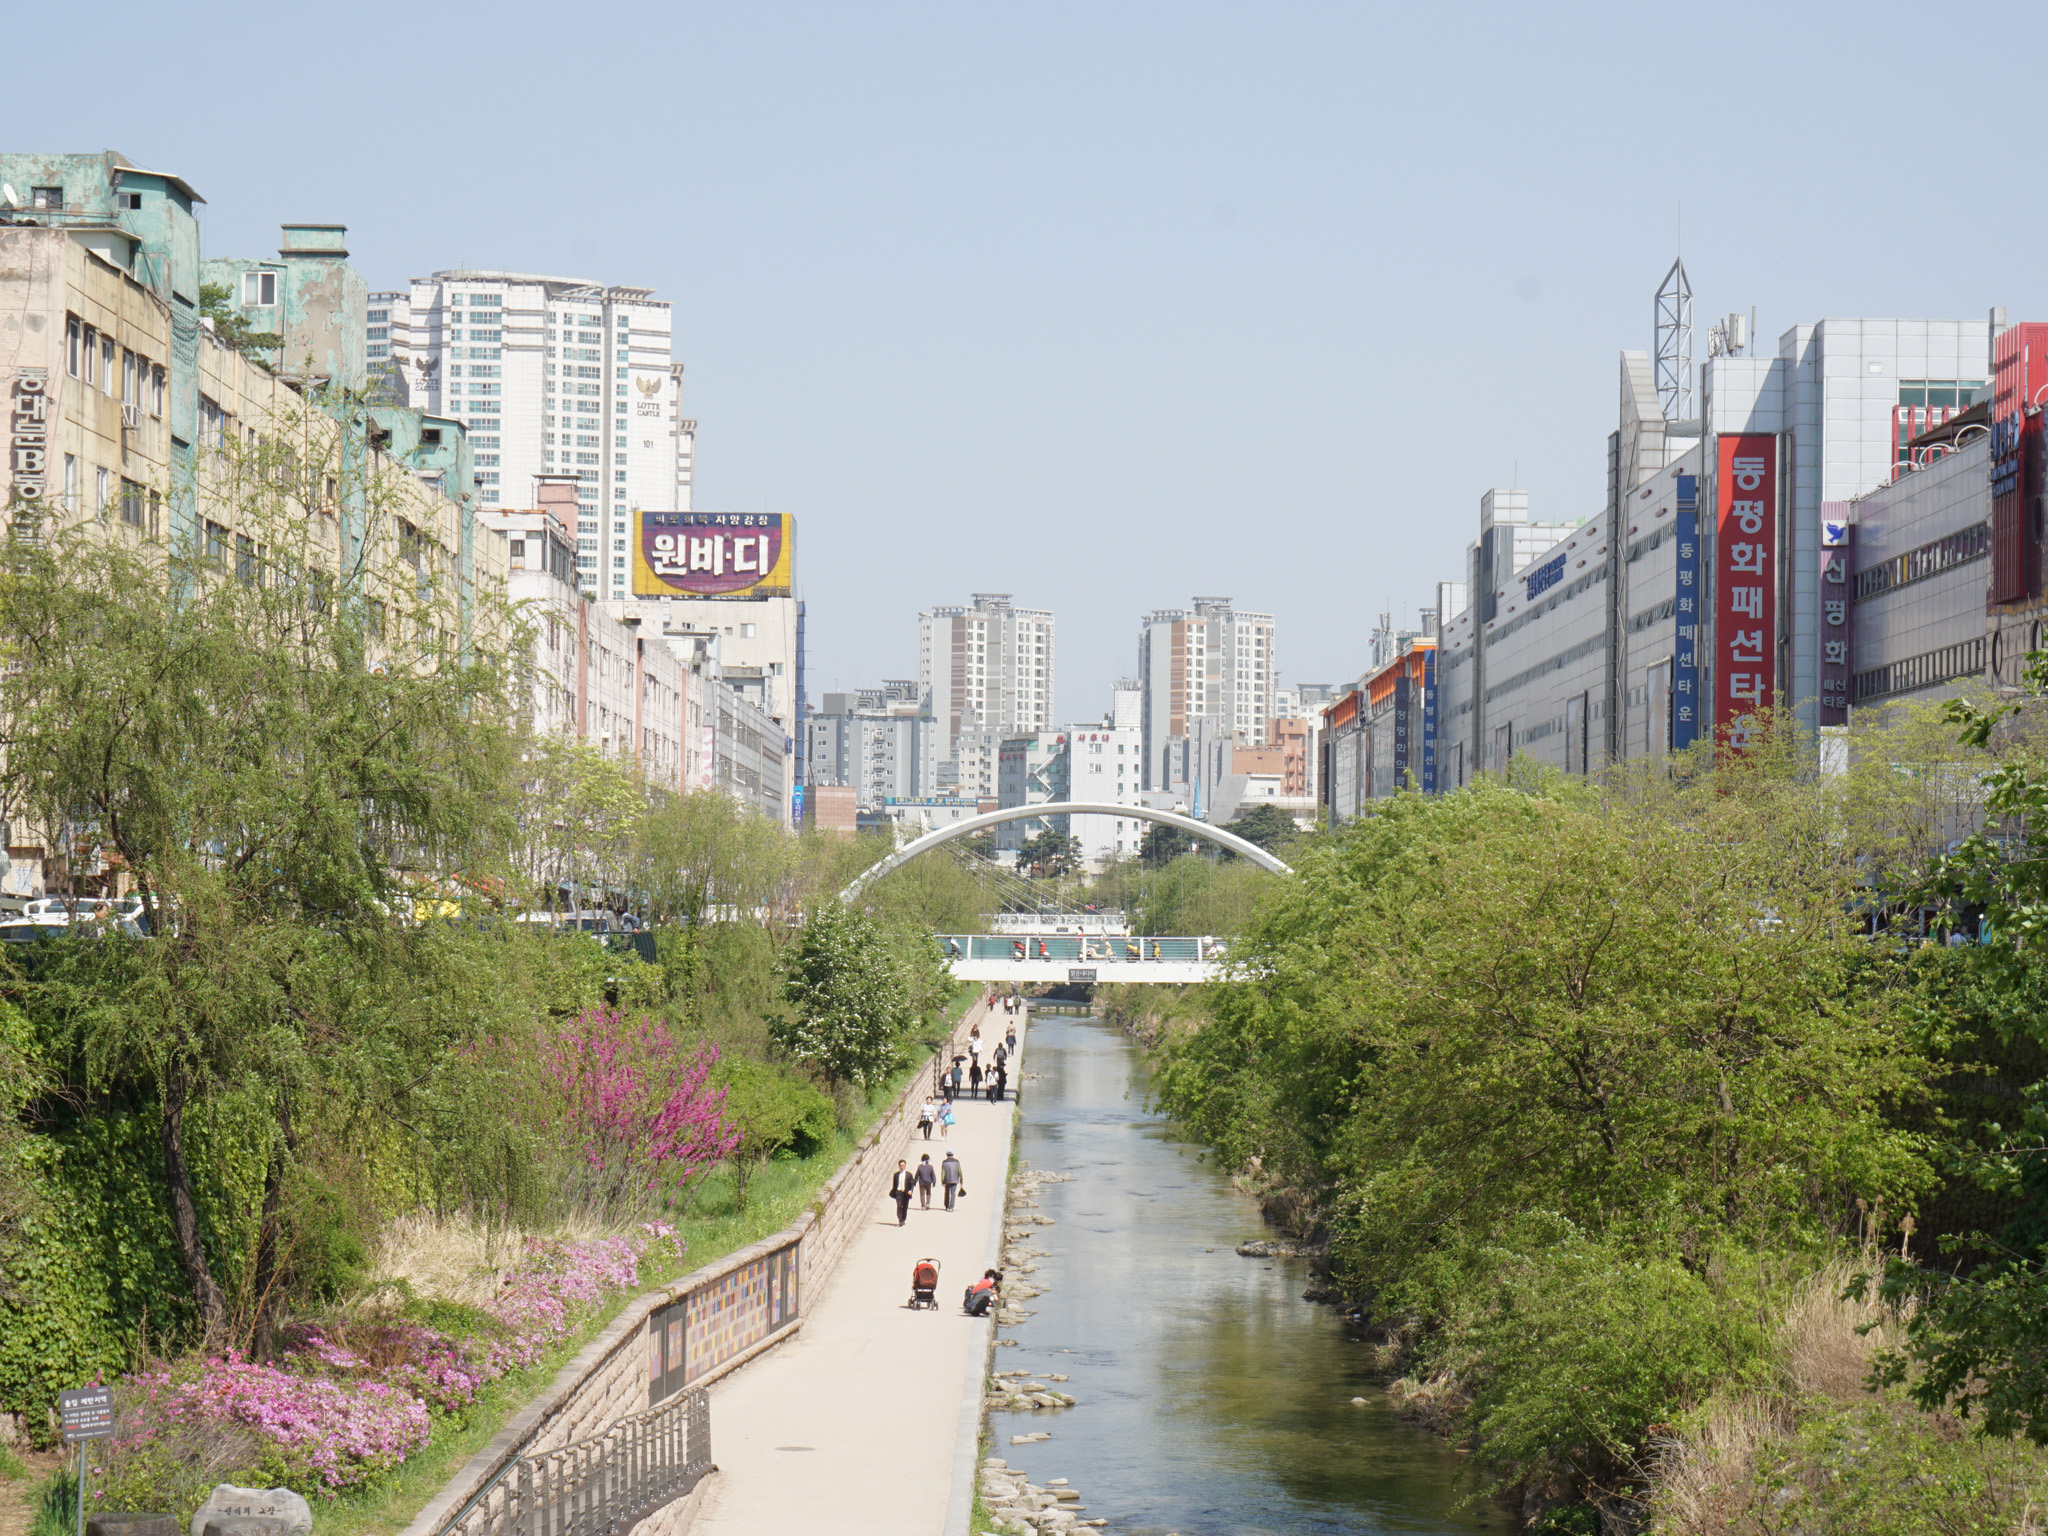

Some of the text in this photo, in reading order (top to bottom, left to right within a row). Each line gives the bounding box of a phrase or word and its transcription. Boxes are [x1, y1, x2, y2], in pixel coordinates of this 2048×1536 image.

[415, 378, 440, 386] LOTTE
[636, 402, 661, 410] LOTTE
[636, 409, 661, 418] CASTLE
[643, 440, 654, 449] 101
[1729, 456, 1767, 748] 동평화패션타운
[1824, 558, 1848, 665] 신평화
[1678, 543, 1695, 722] 동평화패션타운
[1822, 696, 1847, 709] 타운
[80, 1395, 107, 1405] 제한지역
